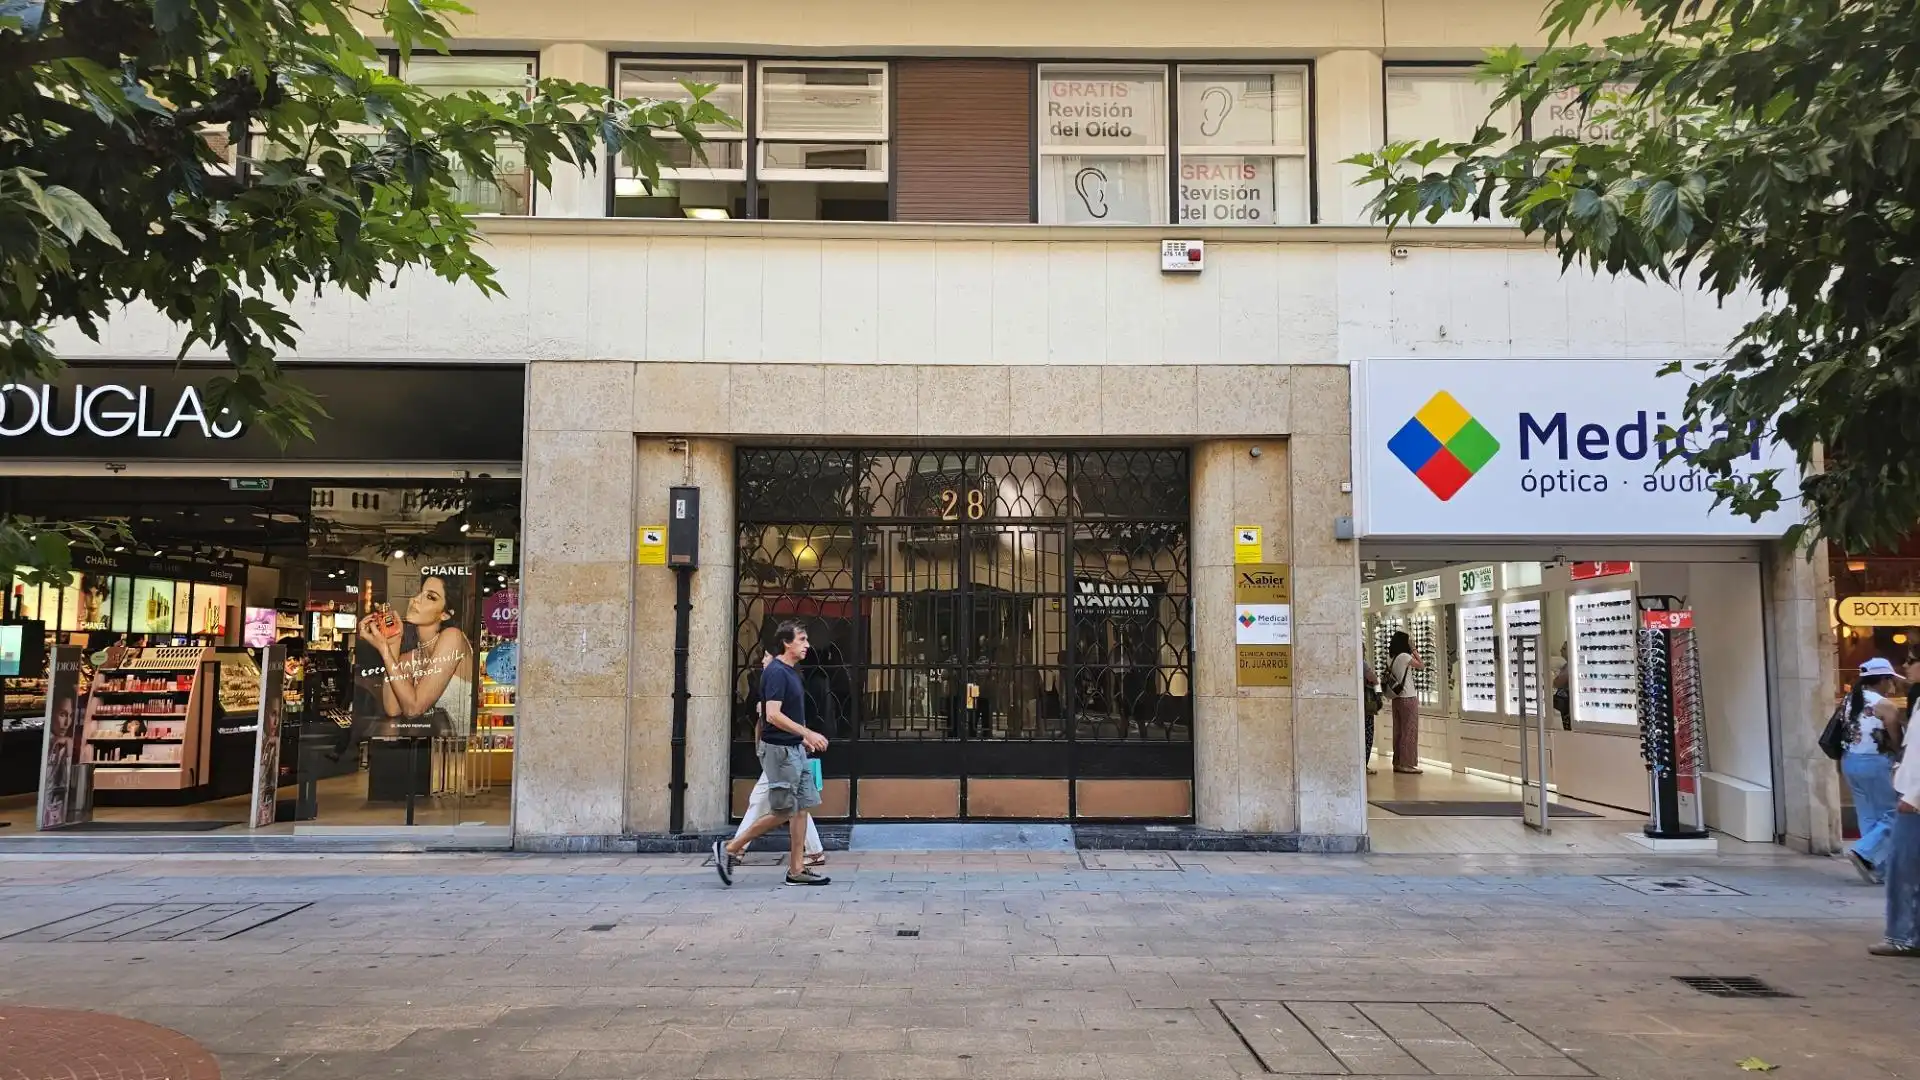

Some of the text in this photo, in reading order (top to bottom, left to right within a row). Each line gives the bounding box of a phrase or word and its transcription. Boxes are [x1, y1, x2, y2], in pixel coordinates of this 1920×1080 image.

[1053, 82, 1128, 97] GRATIS
[1048, 101, 1132, 118] Revisión
[1050, 121, 1132, 137] del Oído
[1181, 164, 1256, 180] GRATIS
[1213, 204, 1260, 220] Oído
[1521, 469, 1608, 498] óptica
[85, 555, 118, 567] CHANEL
[210, 570, 233, 581] sisley
[421, 566, 472, 575] CHANEL
[1853, 602, 1920, 616] BOTXIT
[80, 621, 107, 629] CHANEL
[56, 661, 79, 671] DIOR
[361, 667, 385, 677] COCO
